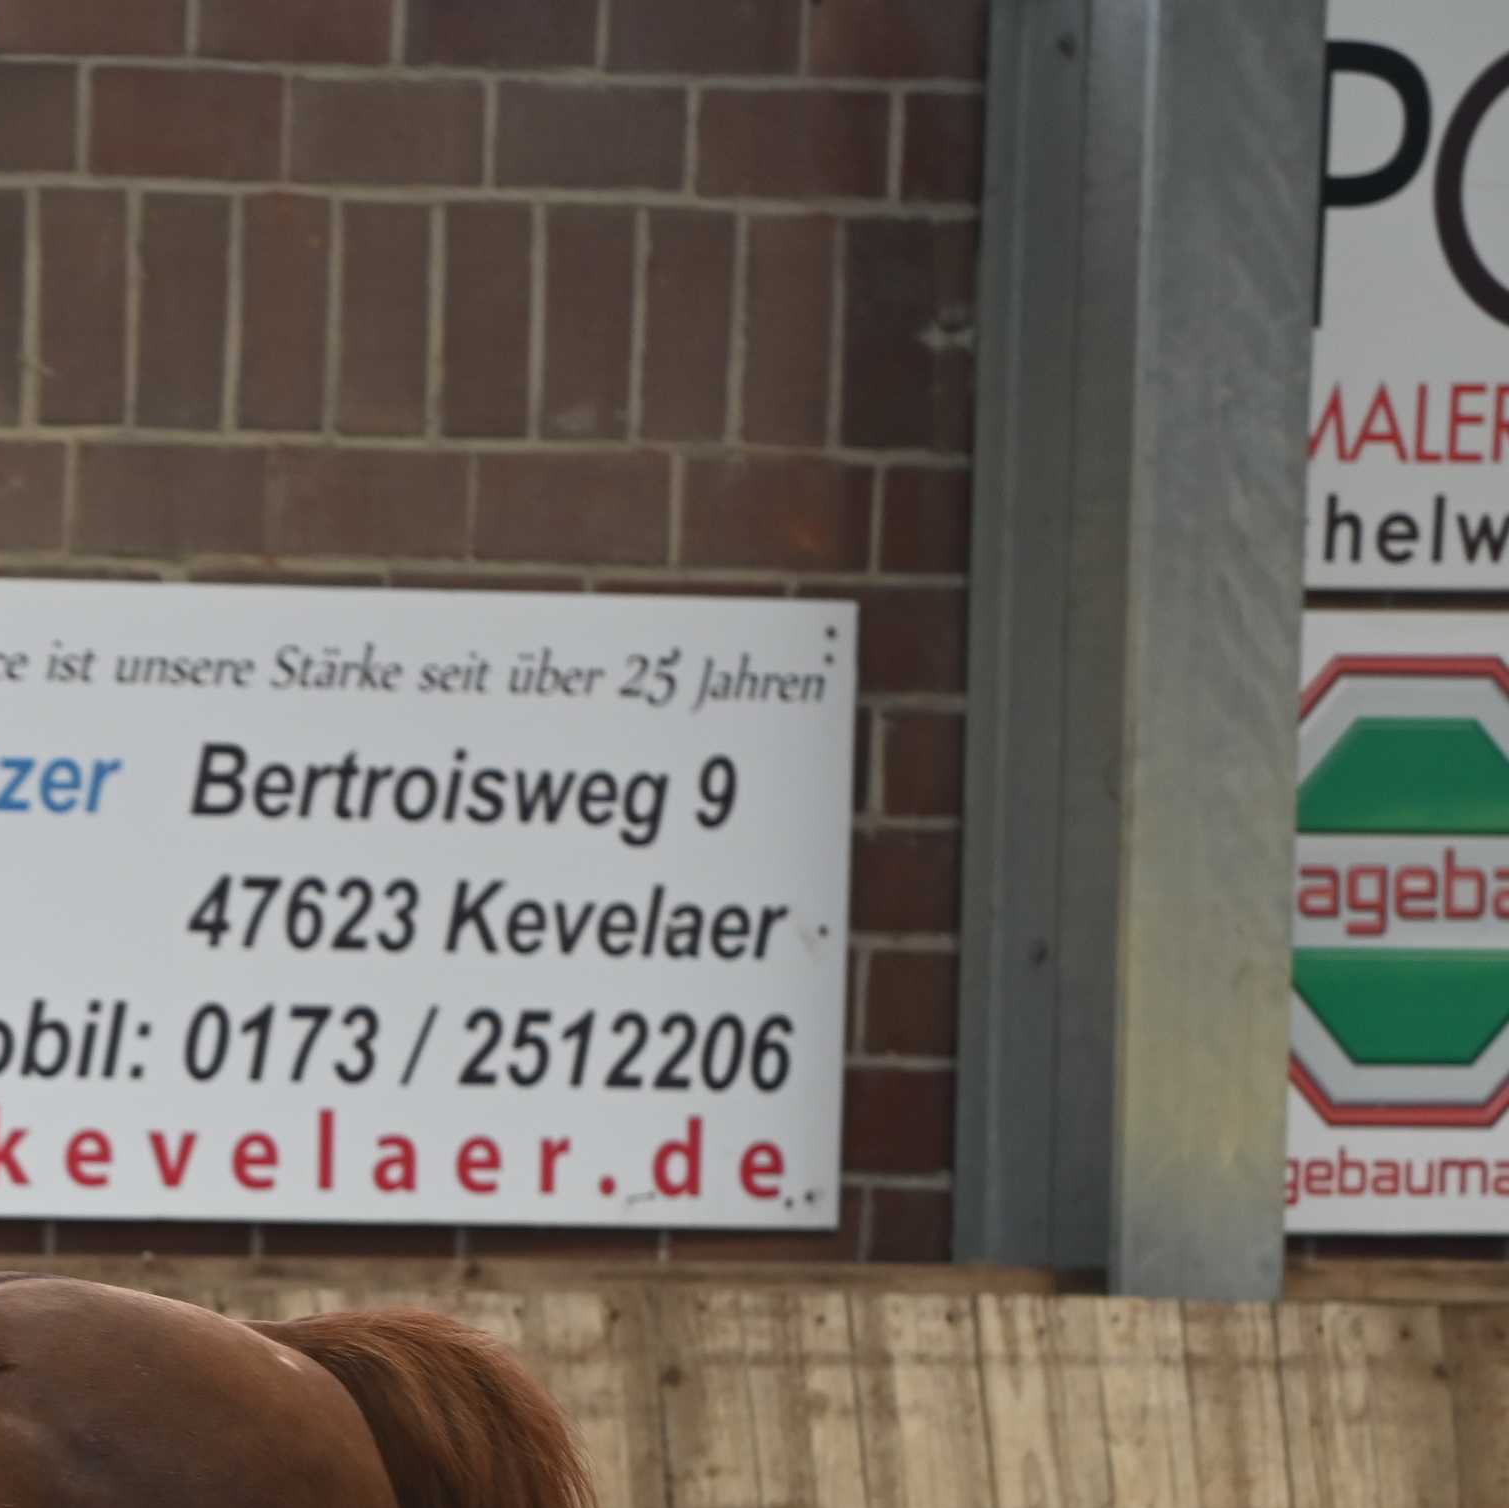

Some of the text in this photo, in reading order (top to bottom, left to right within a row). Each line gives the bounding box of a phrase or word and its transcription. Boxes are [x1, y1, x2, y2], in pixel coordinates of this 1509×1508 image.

[46, 641, 96, 683] ist
[114, 656, 256, 688] unsere
[270, 642, 403, 692] Stärke
[418, 652, 490, 694] seit
[507, 647, 606, 697] über
[618, 647, 682, 707] 25
[692, 653, 826, 712] Jahren
[190, 742, 739, 849] Bertroisweg 9
[186, 873, 790, 961] 47623 Kevelaer
[184, 1002, 380, 1085] 0173
[458, 1007, 795, 1094] 2512206
